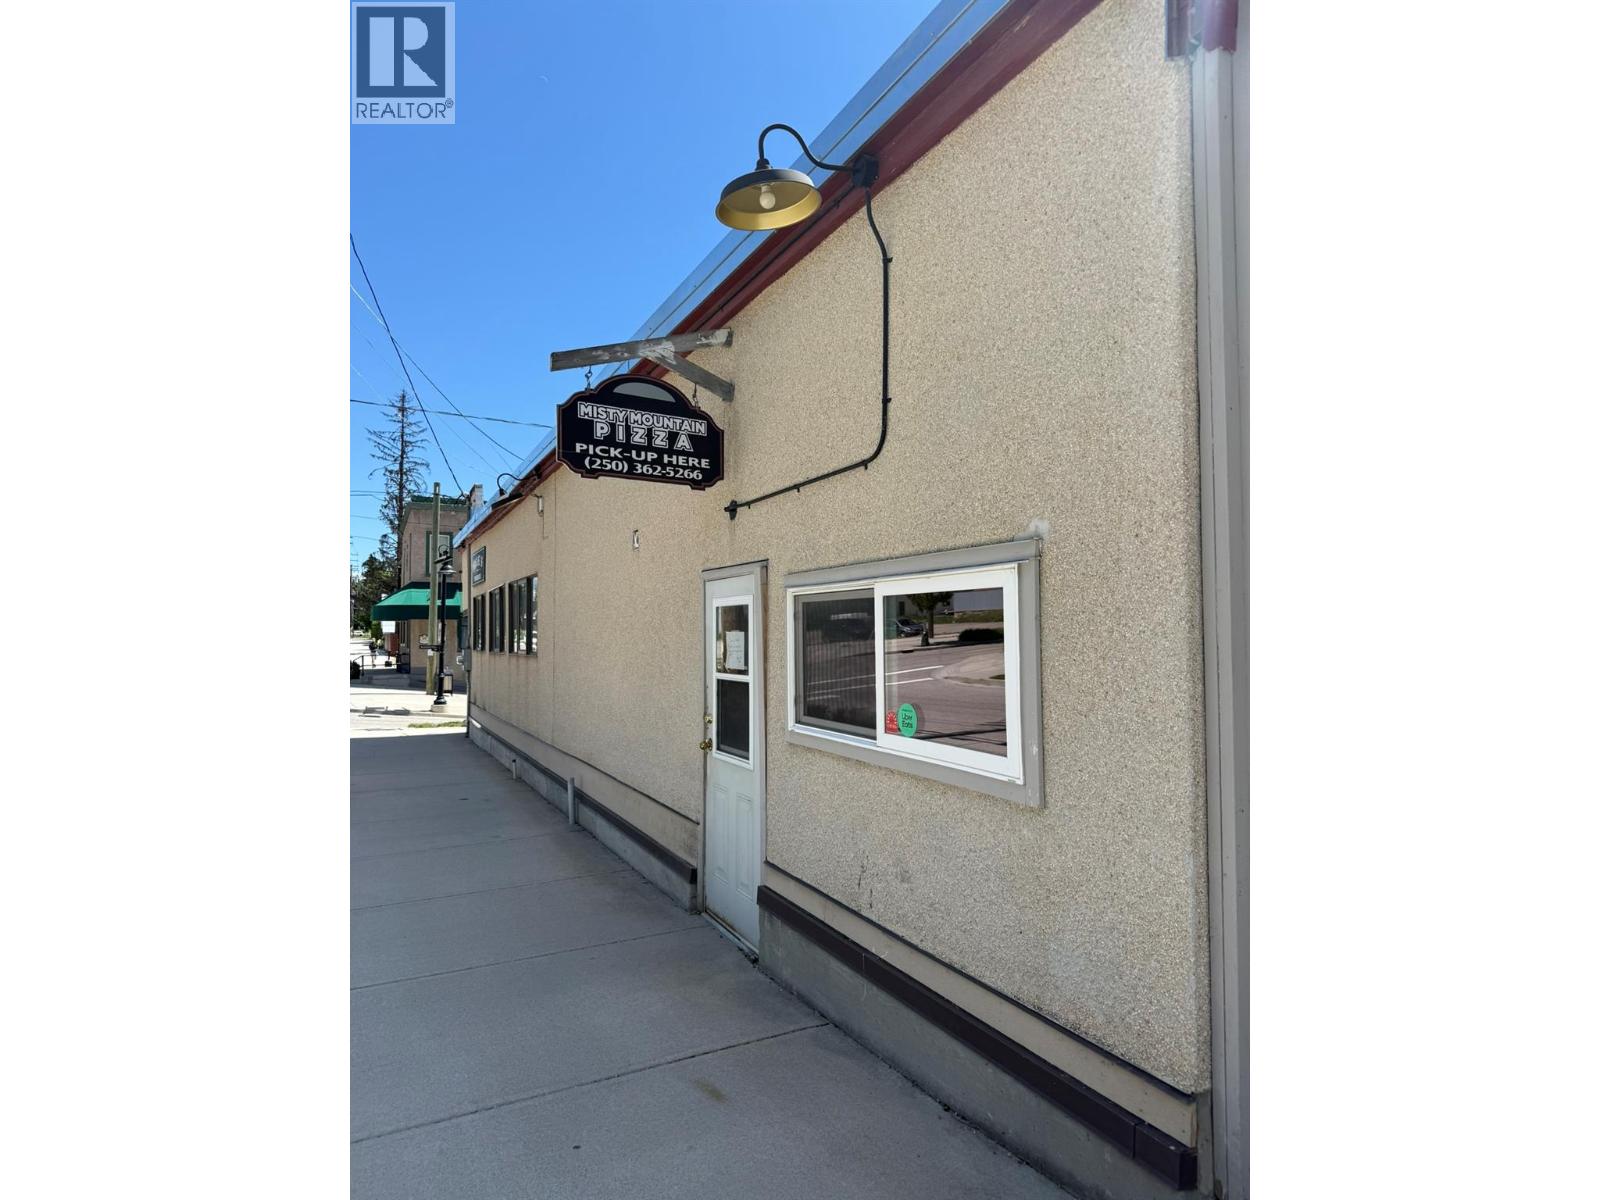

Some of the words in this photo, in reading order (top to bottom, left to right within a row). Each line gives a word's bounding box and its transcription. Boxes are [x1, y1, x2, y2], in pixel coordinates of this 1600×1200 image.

[577, 401, 628, 423] MISTY
[628, 410, 707, 436] MOUNTAIN
[594, 420, 694, 452] PIZZA
[575, 442, 658, 462] PICK-UP
[663, 454, 711, 469] HERE
[584, 456, 628, 474] (250)
[633, 463, 703, 481] 362-5266
